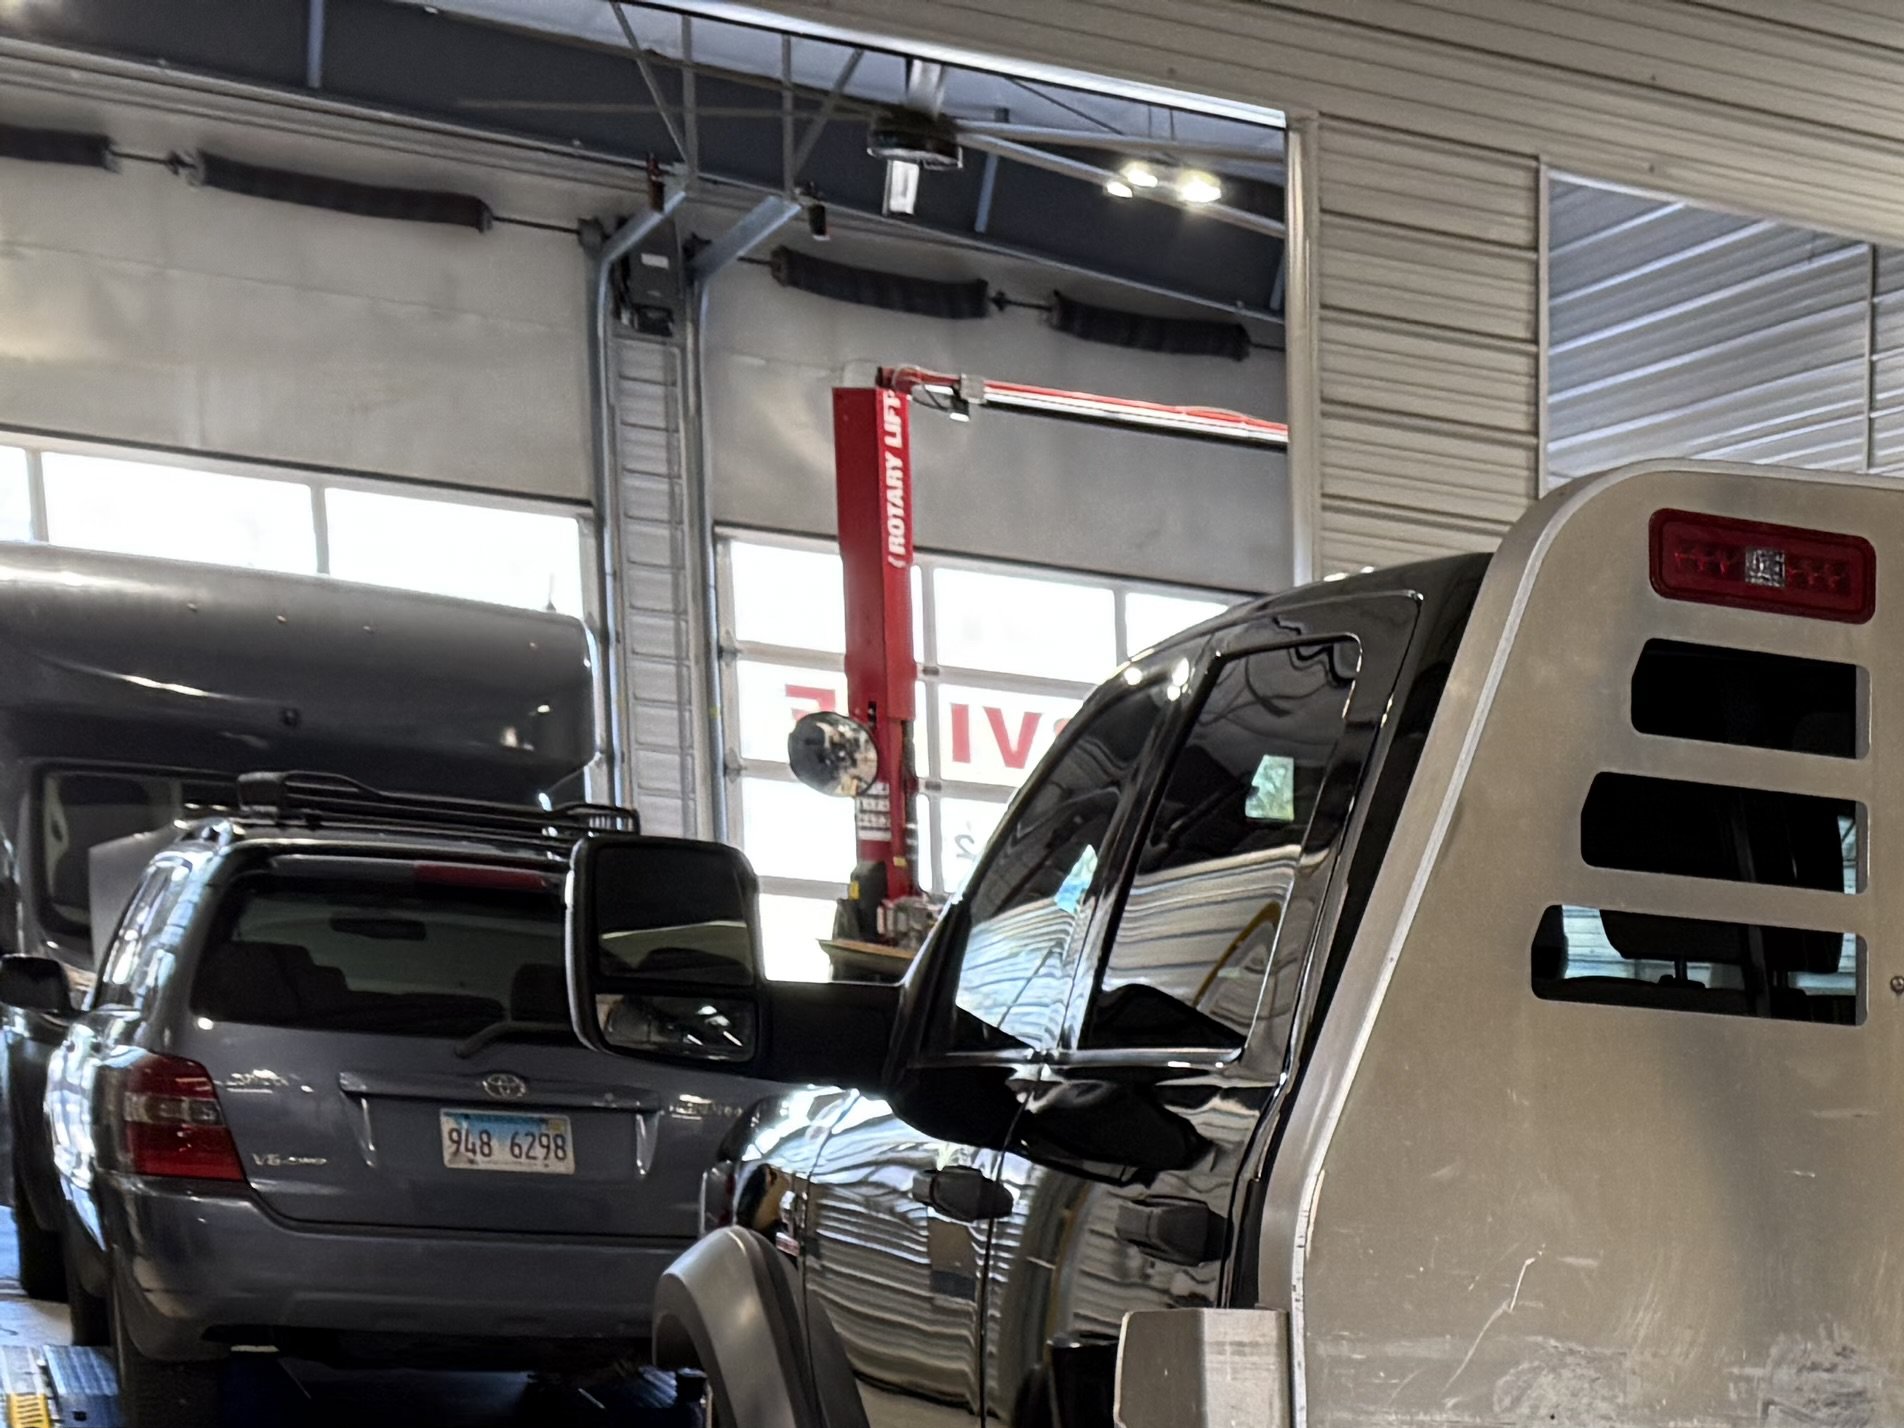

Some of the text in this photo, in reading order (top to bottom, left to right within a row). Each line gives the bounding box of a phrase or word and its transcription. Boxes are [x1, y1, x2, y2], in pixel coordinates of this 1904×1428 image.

[885, 451, 907, 556] ROTARY
[447, 1127, 567, 1161] 948 6298
